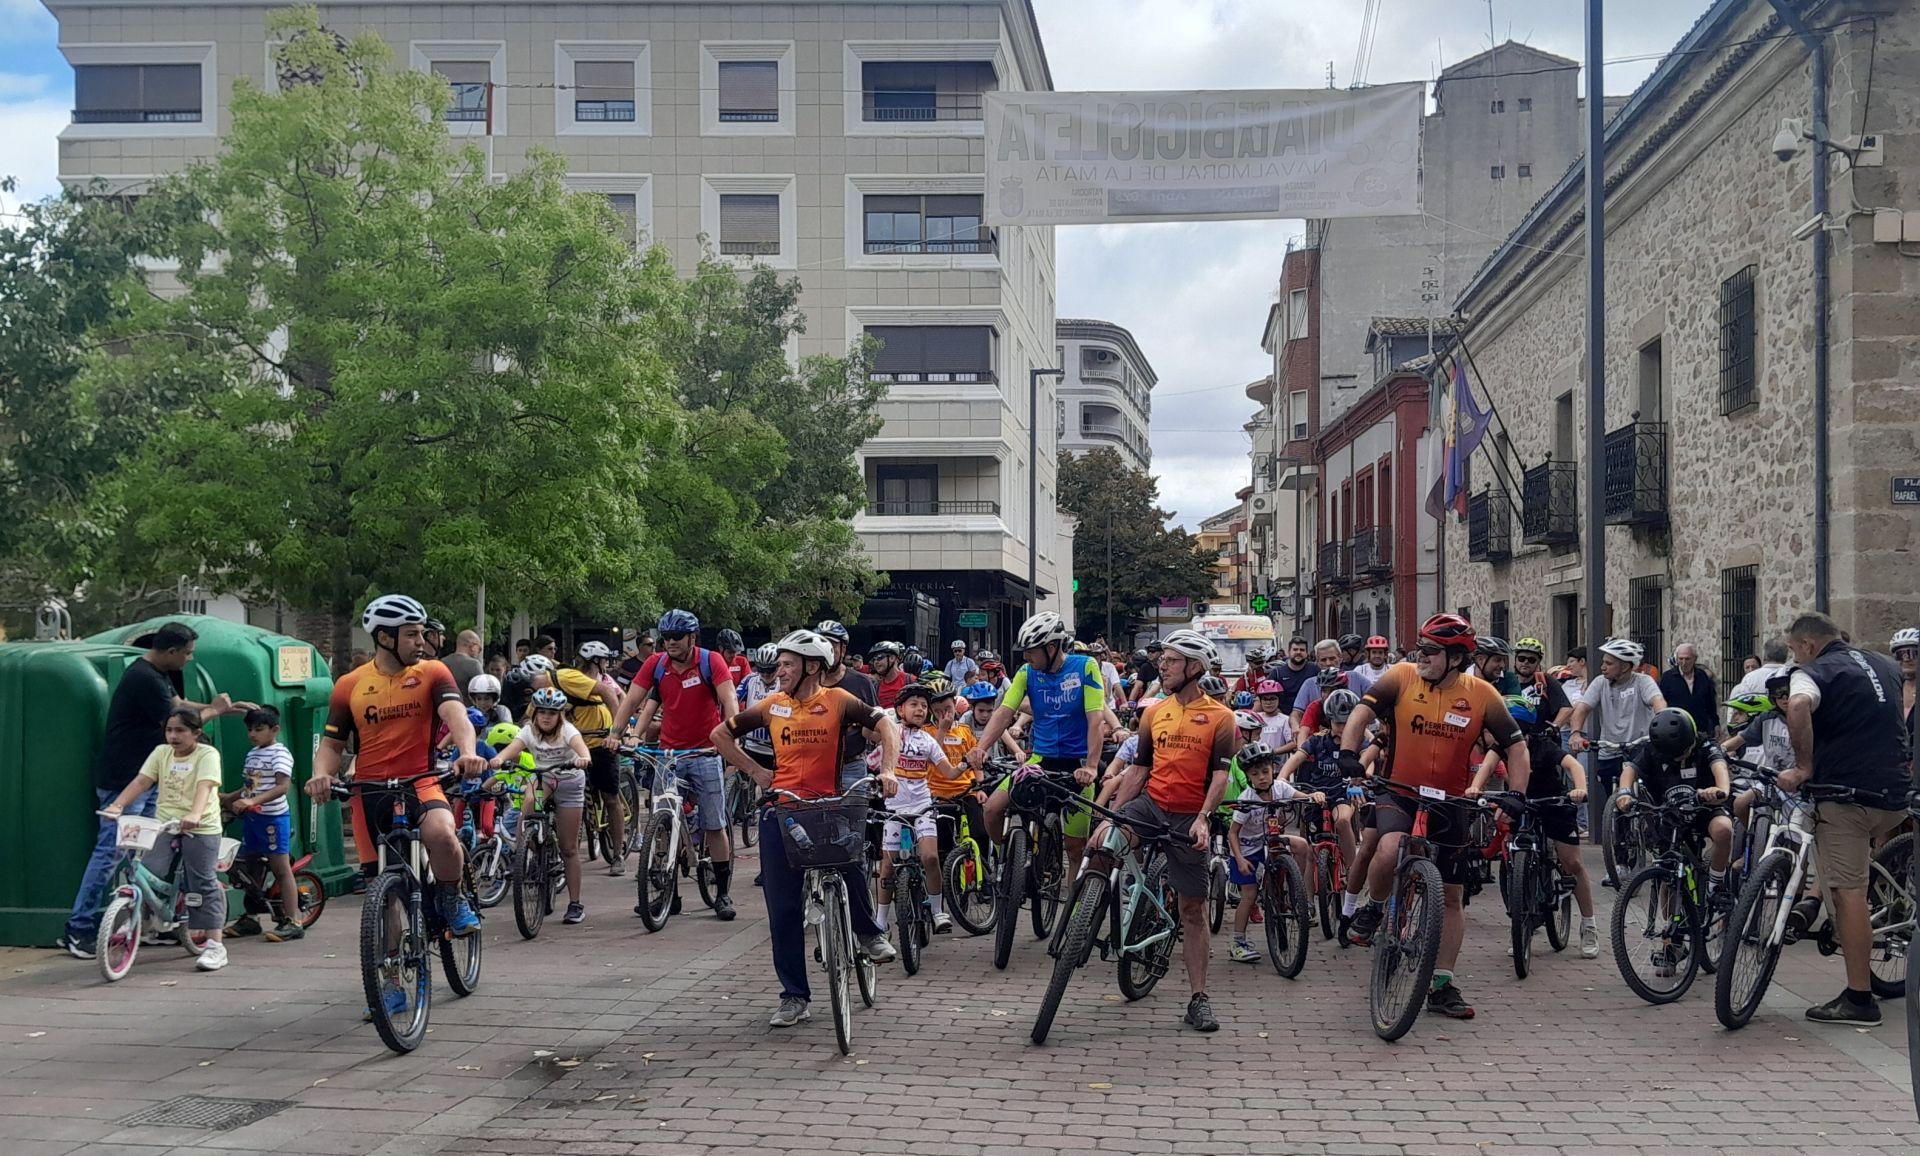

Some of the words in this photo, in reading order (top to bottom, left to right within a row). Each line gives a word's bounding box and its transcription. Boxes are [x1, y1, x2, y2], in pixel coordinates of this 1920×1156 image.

[1895, 491, 1918, 501] RAFAEL
[379, 700, 422, 714] FERRETERÍA
[791, 727, 828, 738] FERRETERÍA
